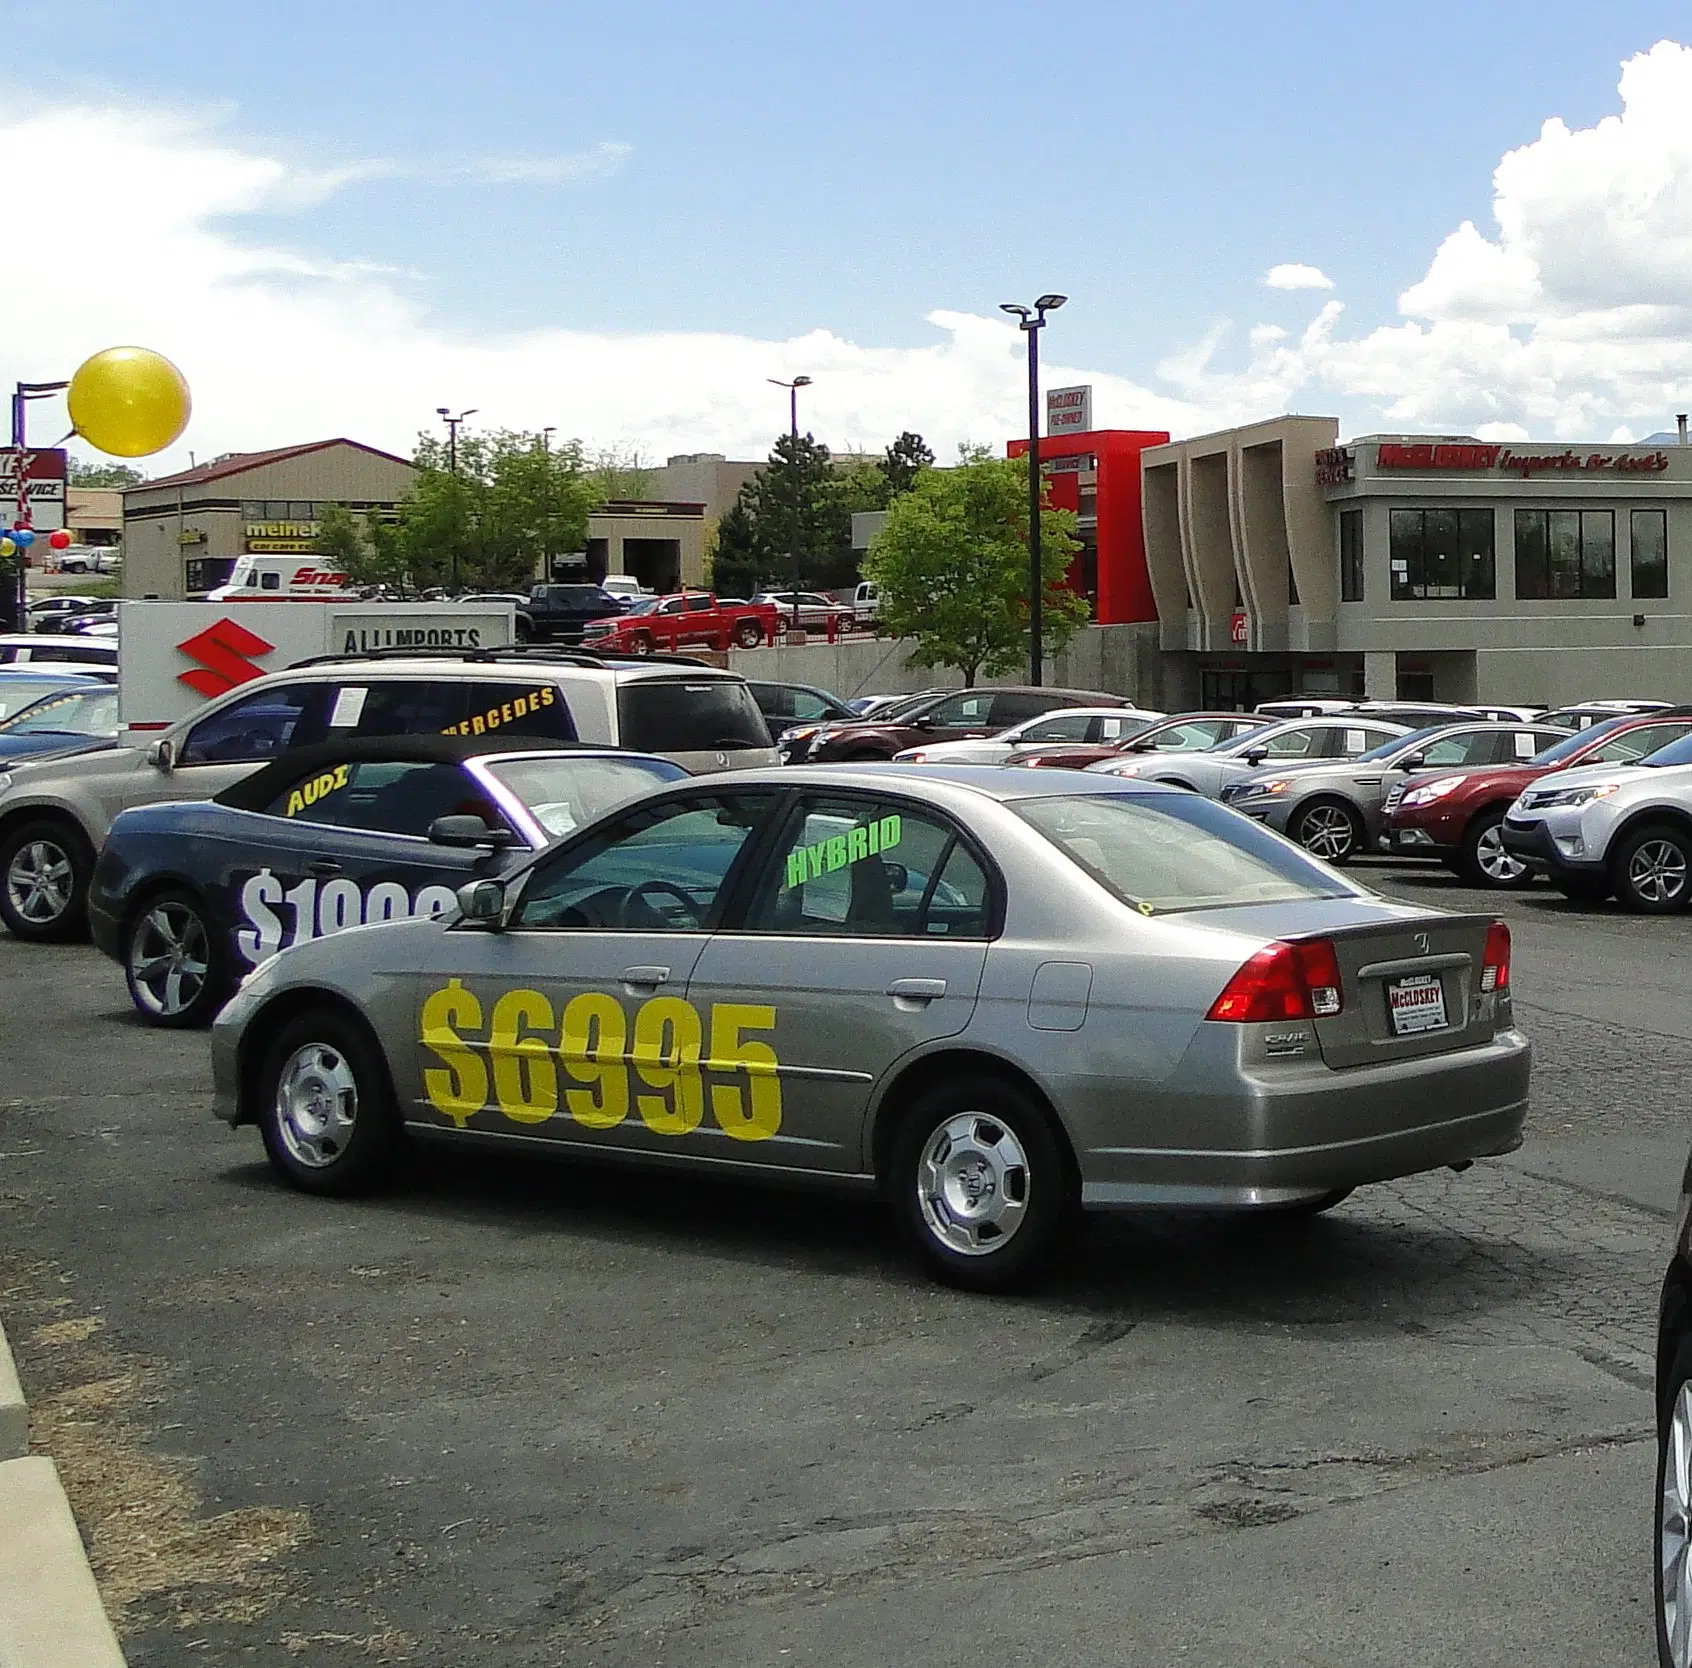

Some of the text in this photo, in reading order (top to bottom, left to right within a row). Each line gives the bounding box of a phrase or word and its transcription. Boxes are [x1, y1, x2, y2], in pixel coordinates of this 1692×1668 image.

[0, 483, 60, 496] SEVICE
[247, 522, 322, 537] meinek
[286, 763, 350, 817] AUDI
[787, 814, 901, 889] HYBRID
[1391, 986, 1440, 1009] McCLOSKEY
[422, 978, 782, 1141] $6995
